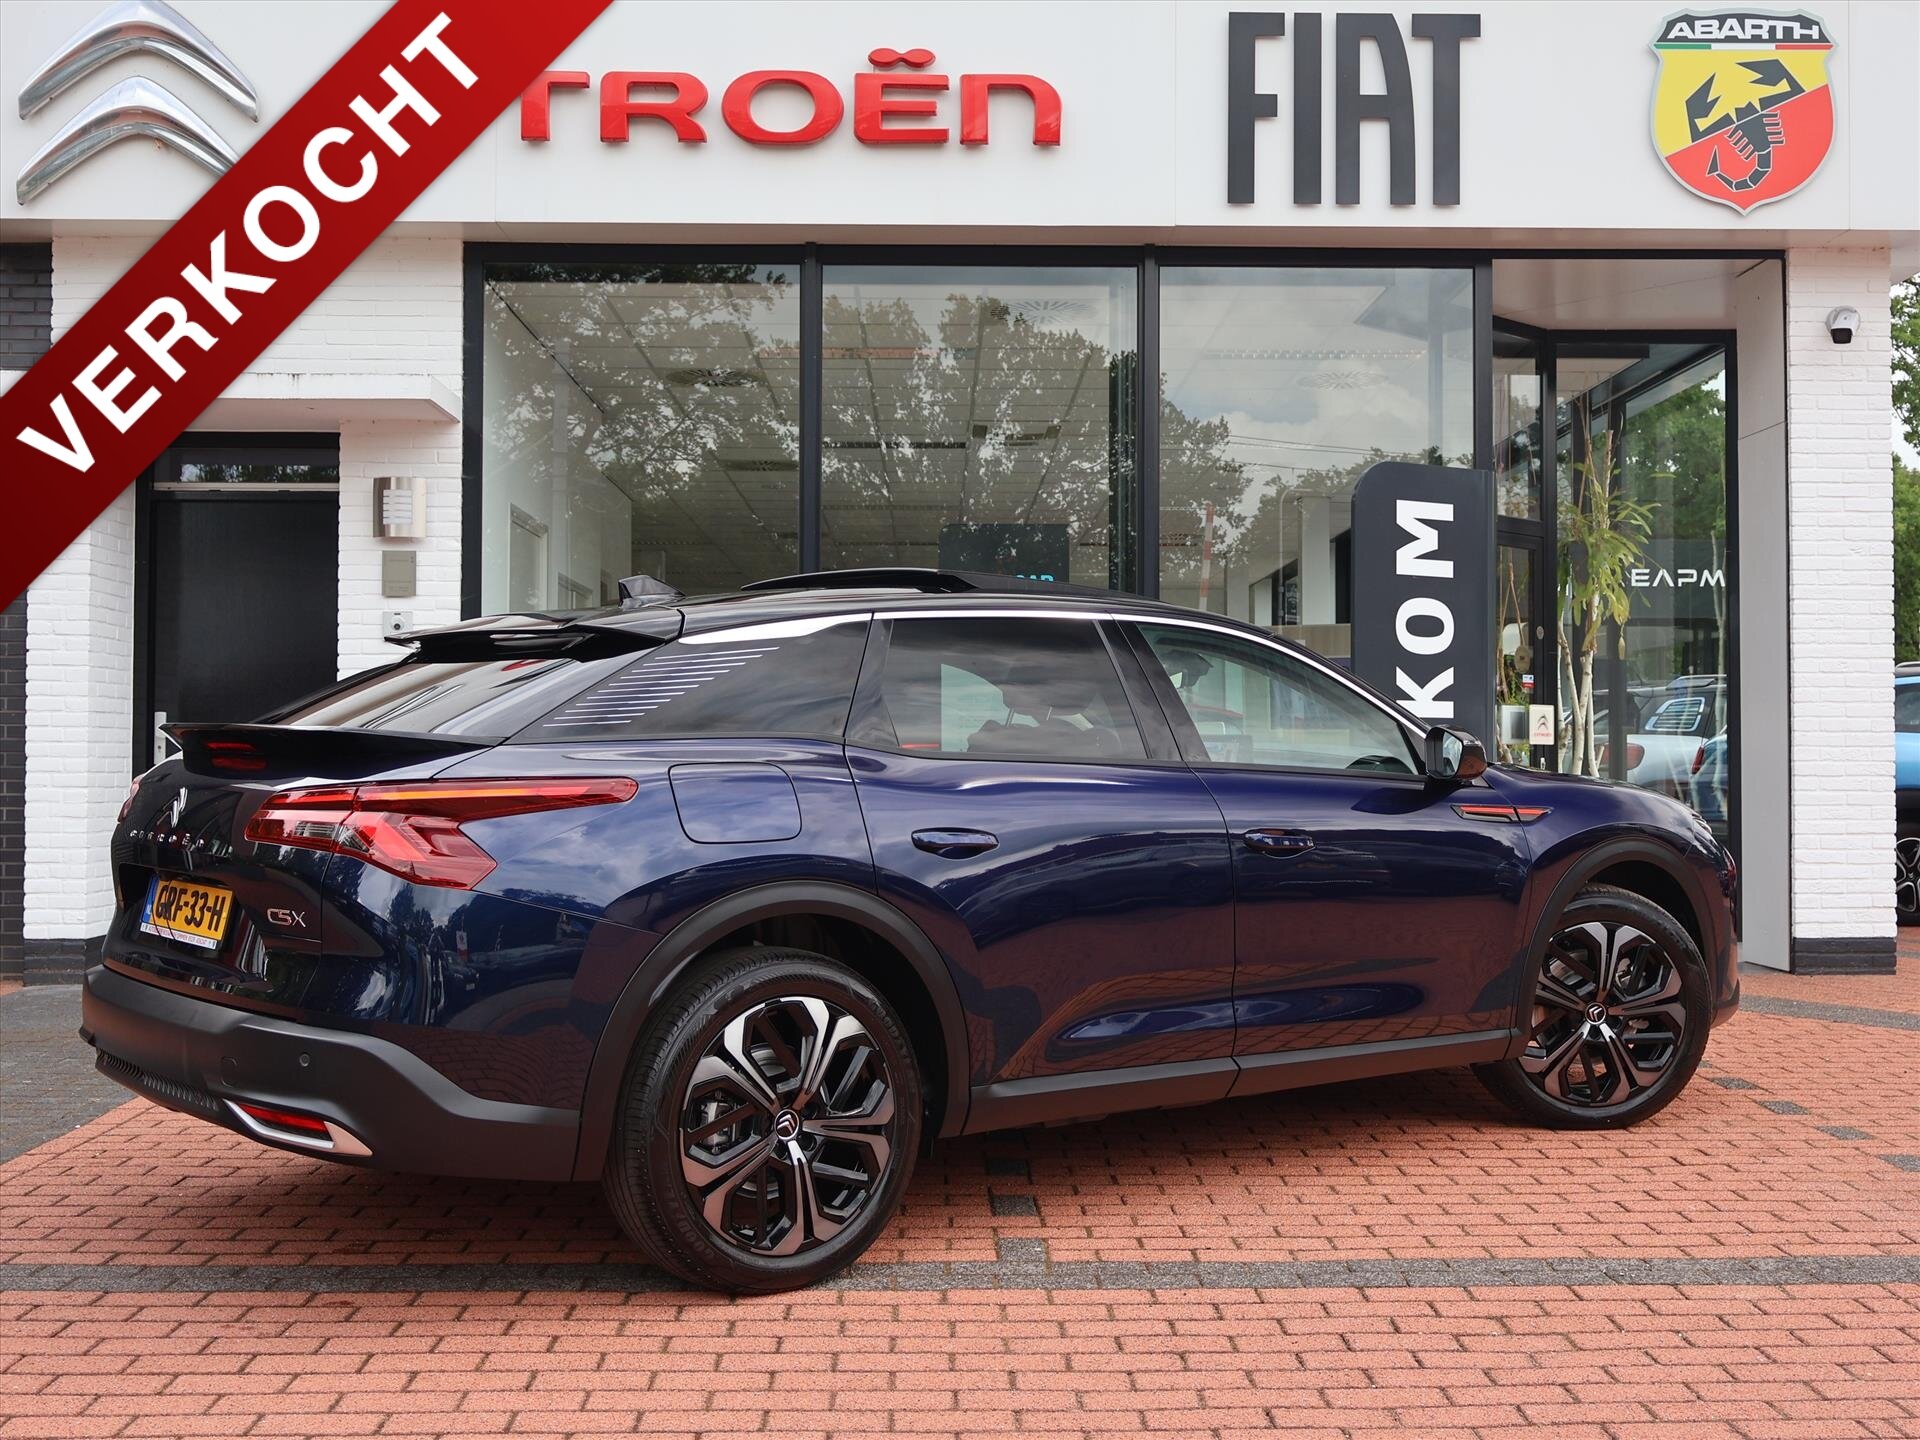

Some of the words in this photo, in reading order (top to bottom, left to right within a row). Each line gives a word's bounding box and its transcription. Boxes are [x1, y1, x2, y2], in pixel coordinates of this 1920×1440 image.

[1666, 18, 1820, 40] ABARTH
[1227, 12, 1481, 206] FIAT
[1622, 568, 1726, 588] EAPM
[155, 884, 227, 933] GRF-33-H
